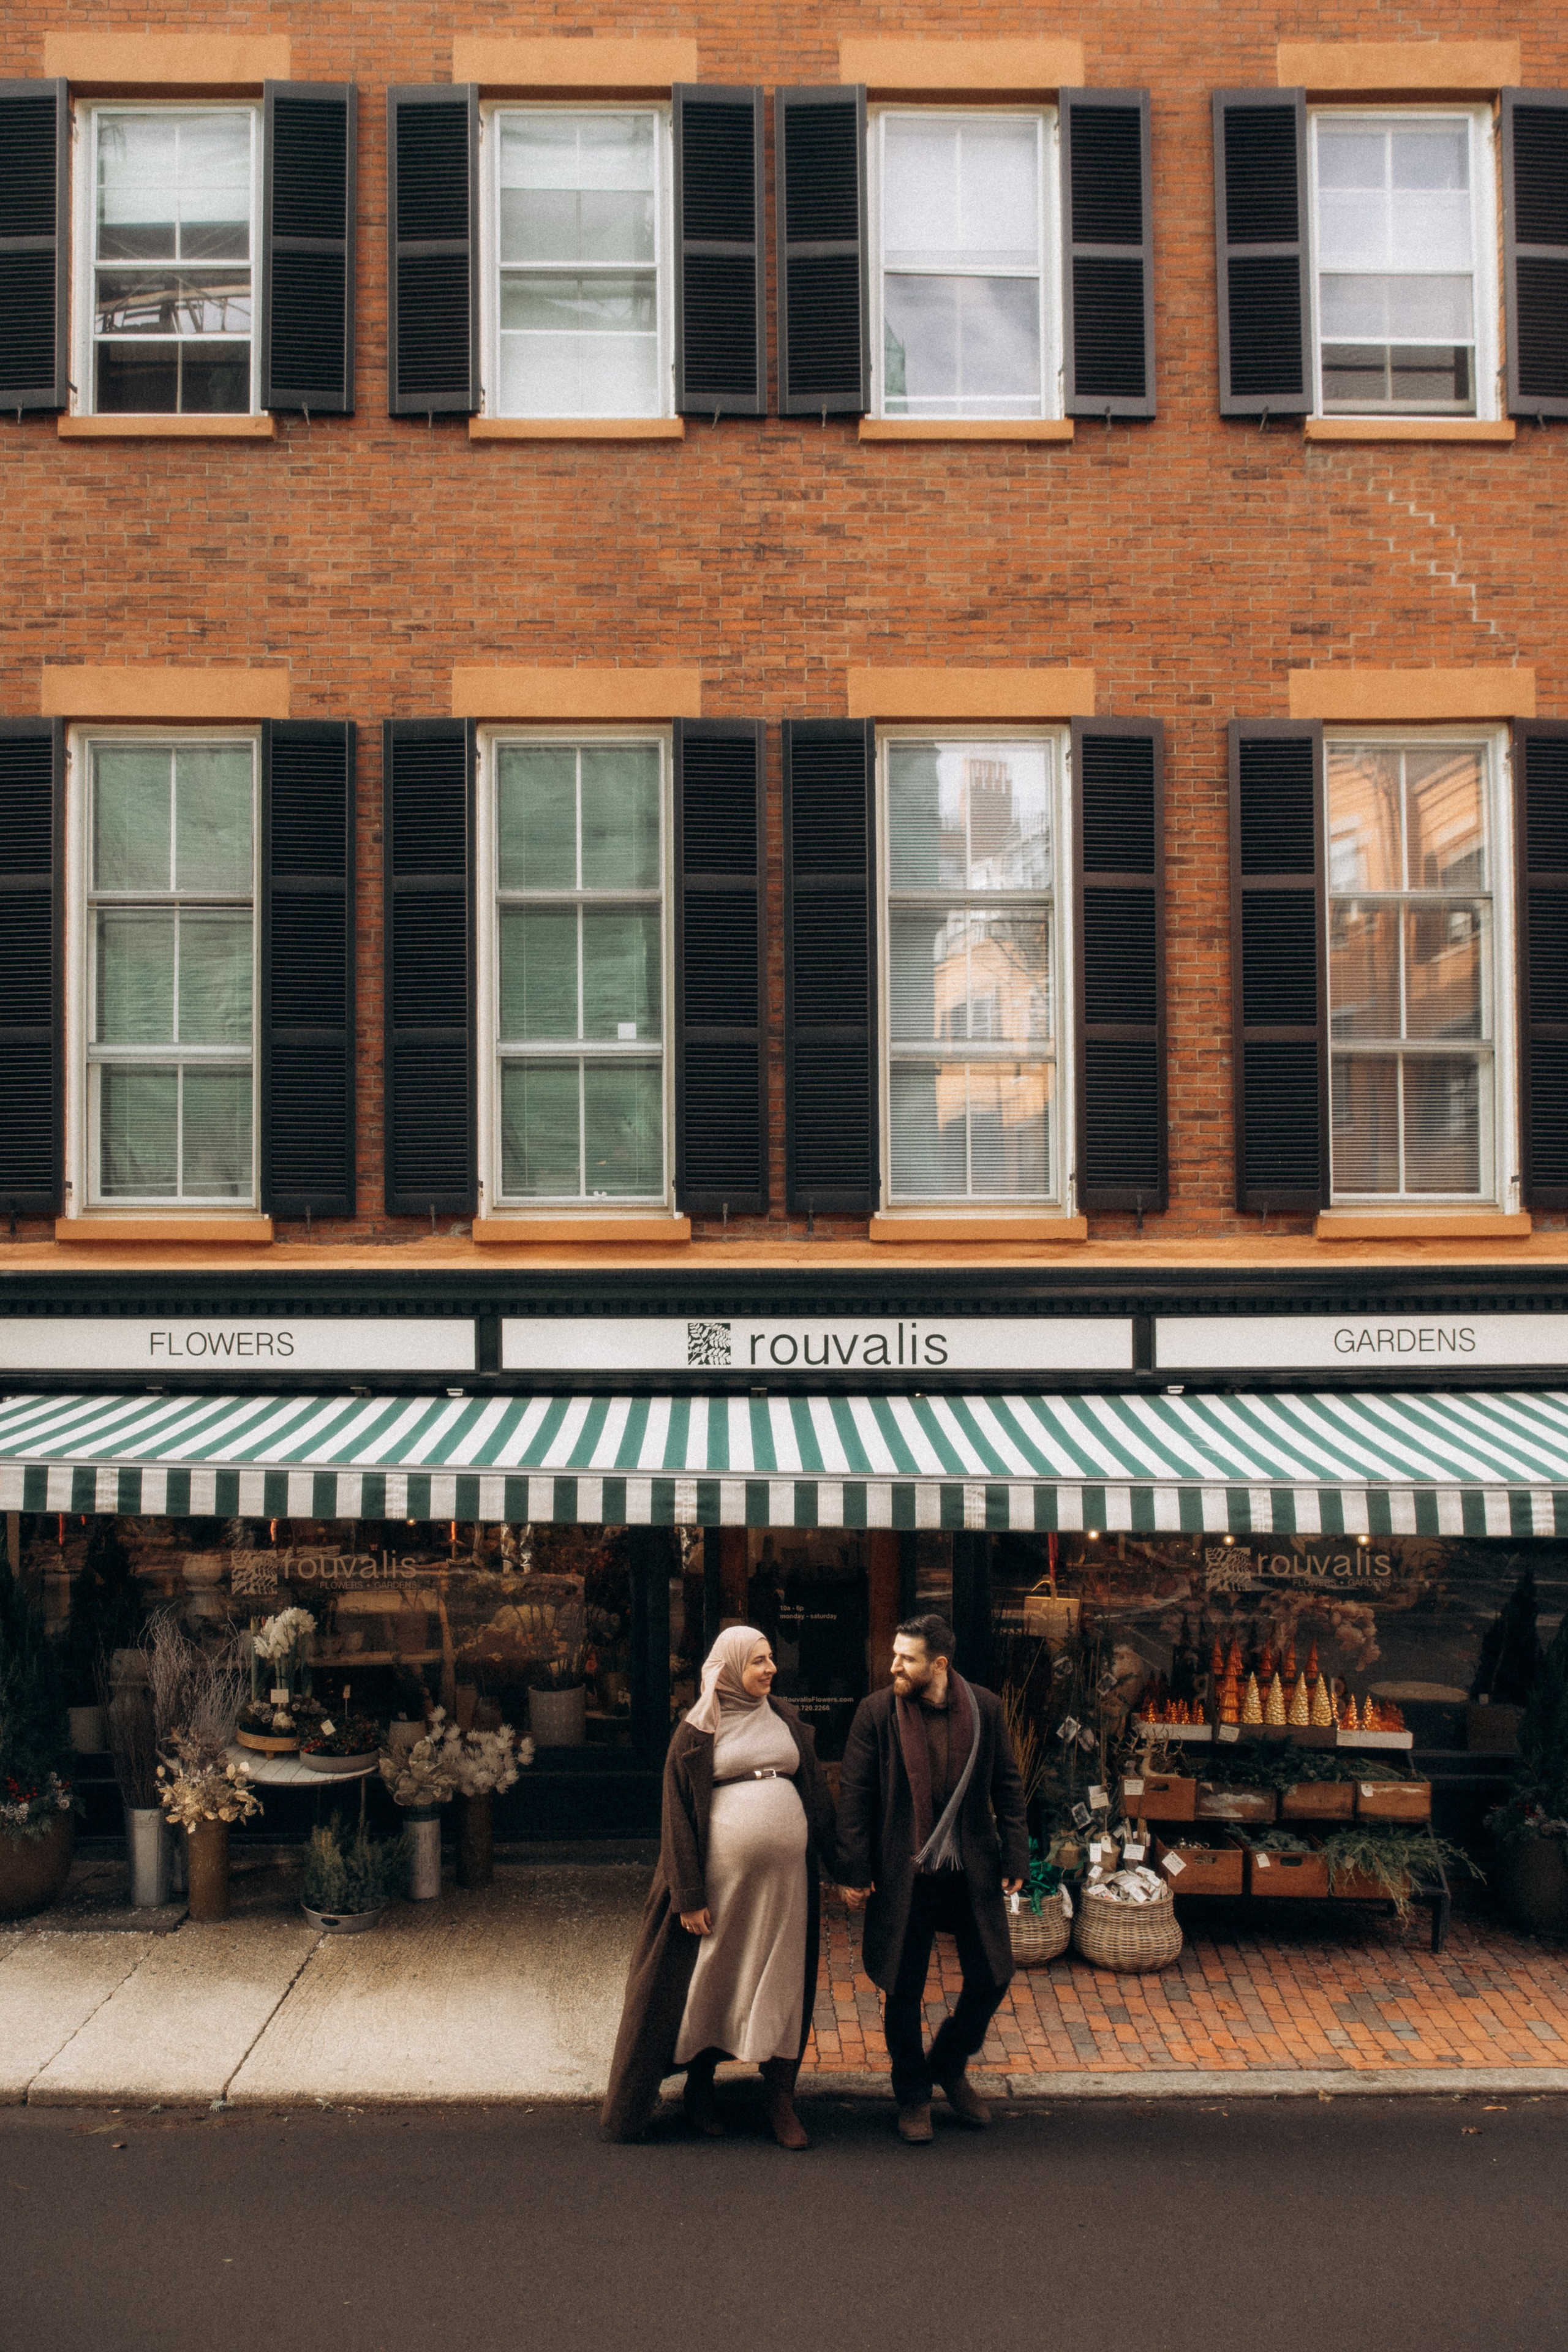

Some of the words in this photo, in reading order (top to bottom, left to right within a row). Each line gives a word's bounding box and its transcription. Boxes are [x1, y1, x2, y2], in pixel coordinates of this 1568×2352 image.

[150, 1332, 295, 1357] FLOWERS
[750, 1322, 948, 1365] rouvalis
[1334, 1327, 1476, 1354] GARDENS
[284, 1549, 417, 1579] rouvalis
[1257, 1547, 1392, 1577] rouvalis
[320, 1581, 363, 1589] FLOWERS
[374, 1581, 418, 1589] GARDENS
[1292, 1578, 1336, 1587] FLOWERS
[1348, 1578, 1392, 1587] GARDENS
